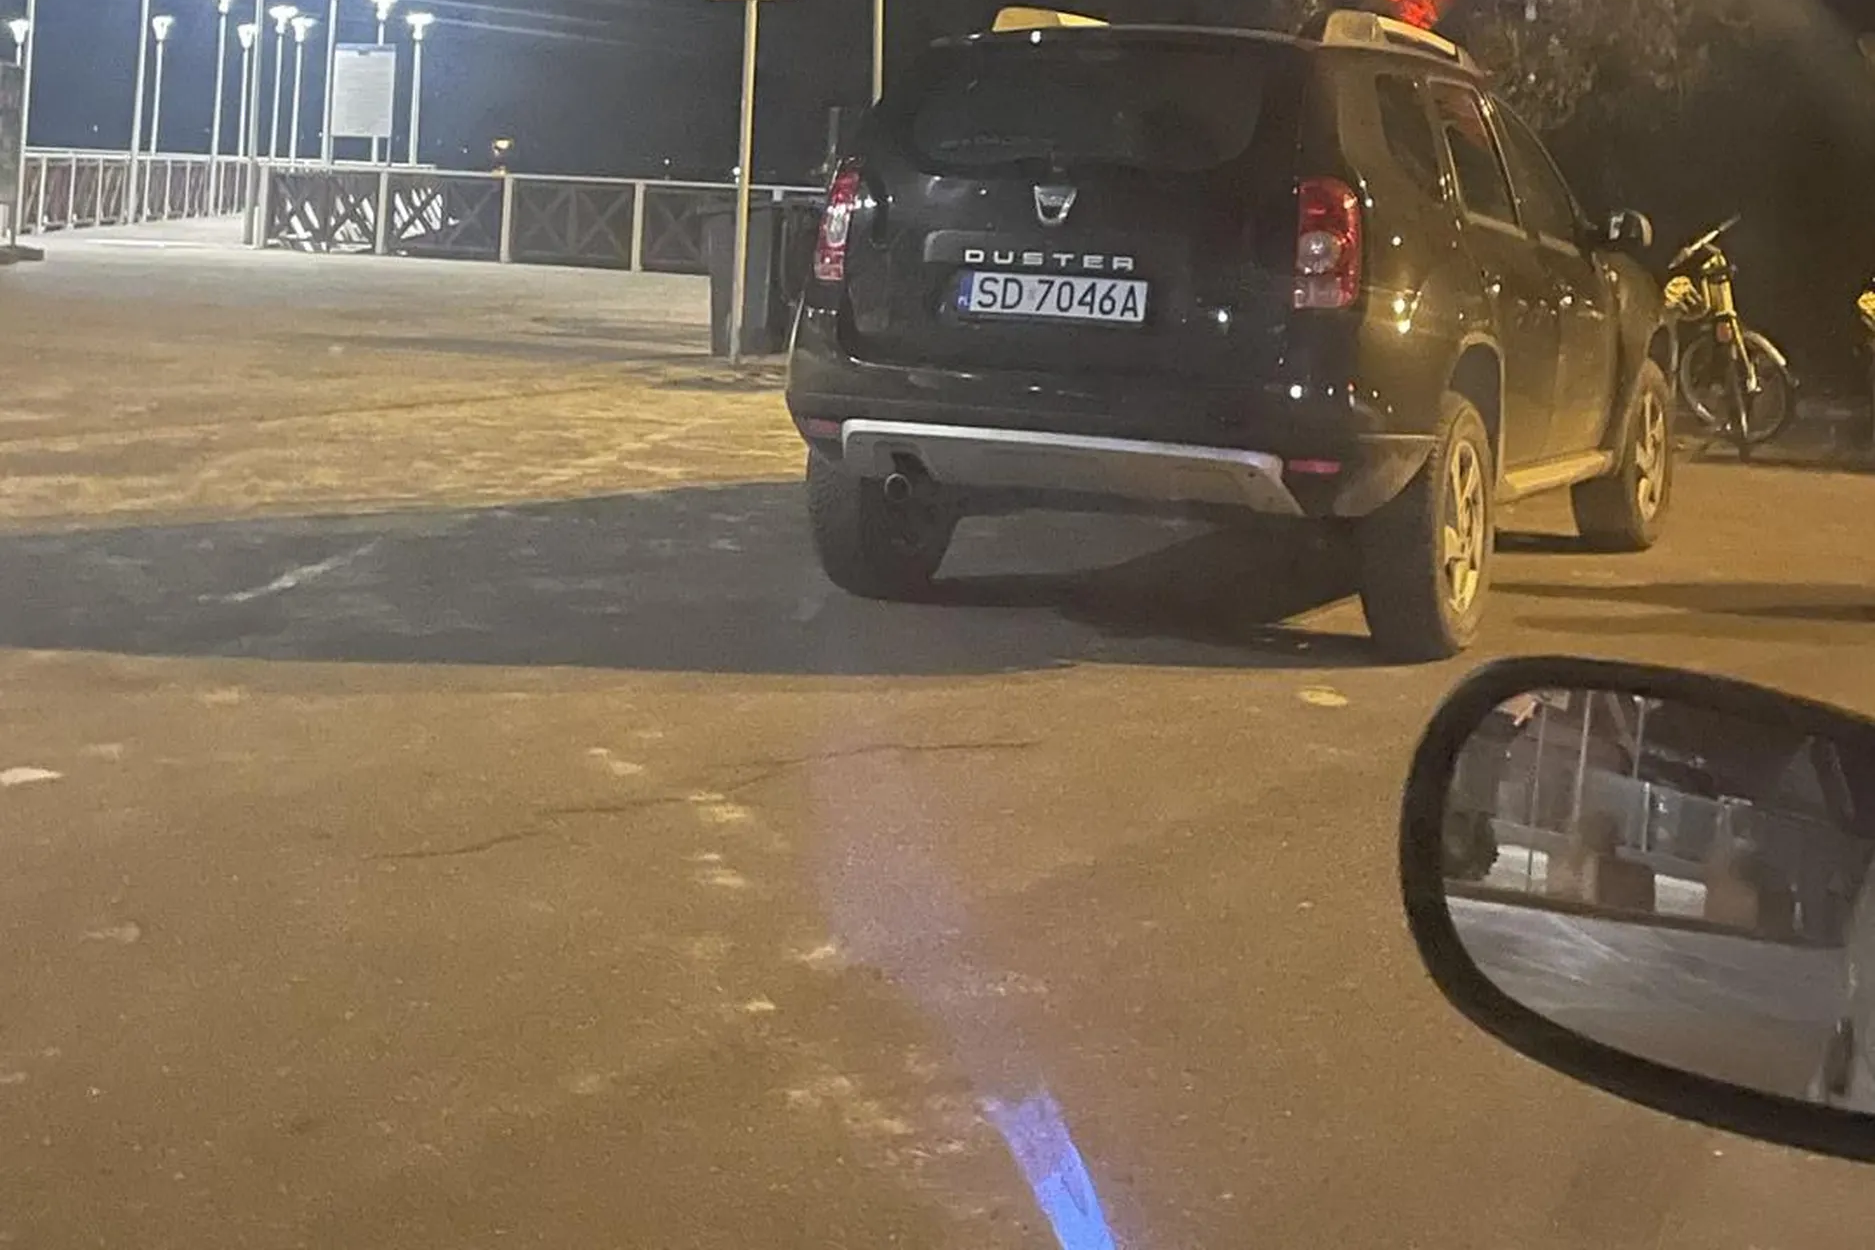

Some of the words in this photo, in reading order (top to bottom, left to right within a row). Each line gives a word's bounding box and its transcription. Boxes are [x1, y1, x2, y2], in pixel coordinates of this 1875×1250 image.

[965, 249, 1135, 271] DUSTER
[977, 276, 1024, 310] SD
[1034, 279, 1139, 319] 7046A
